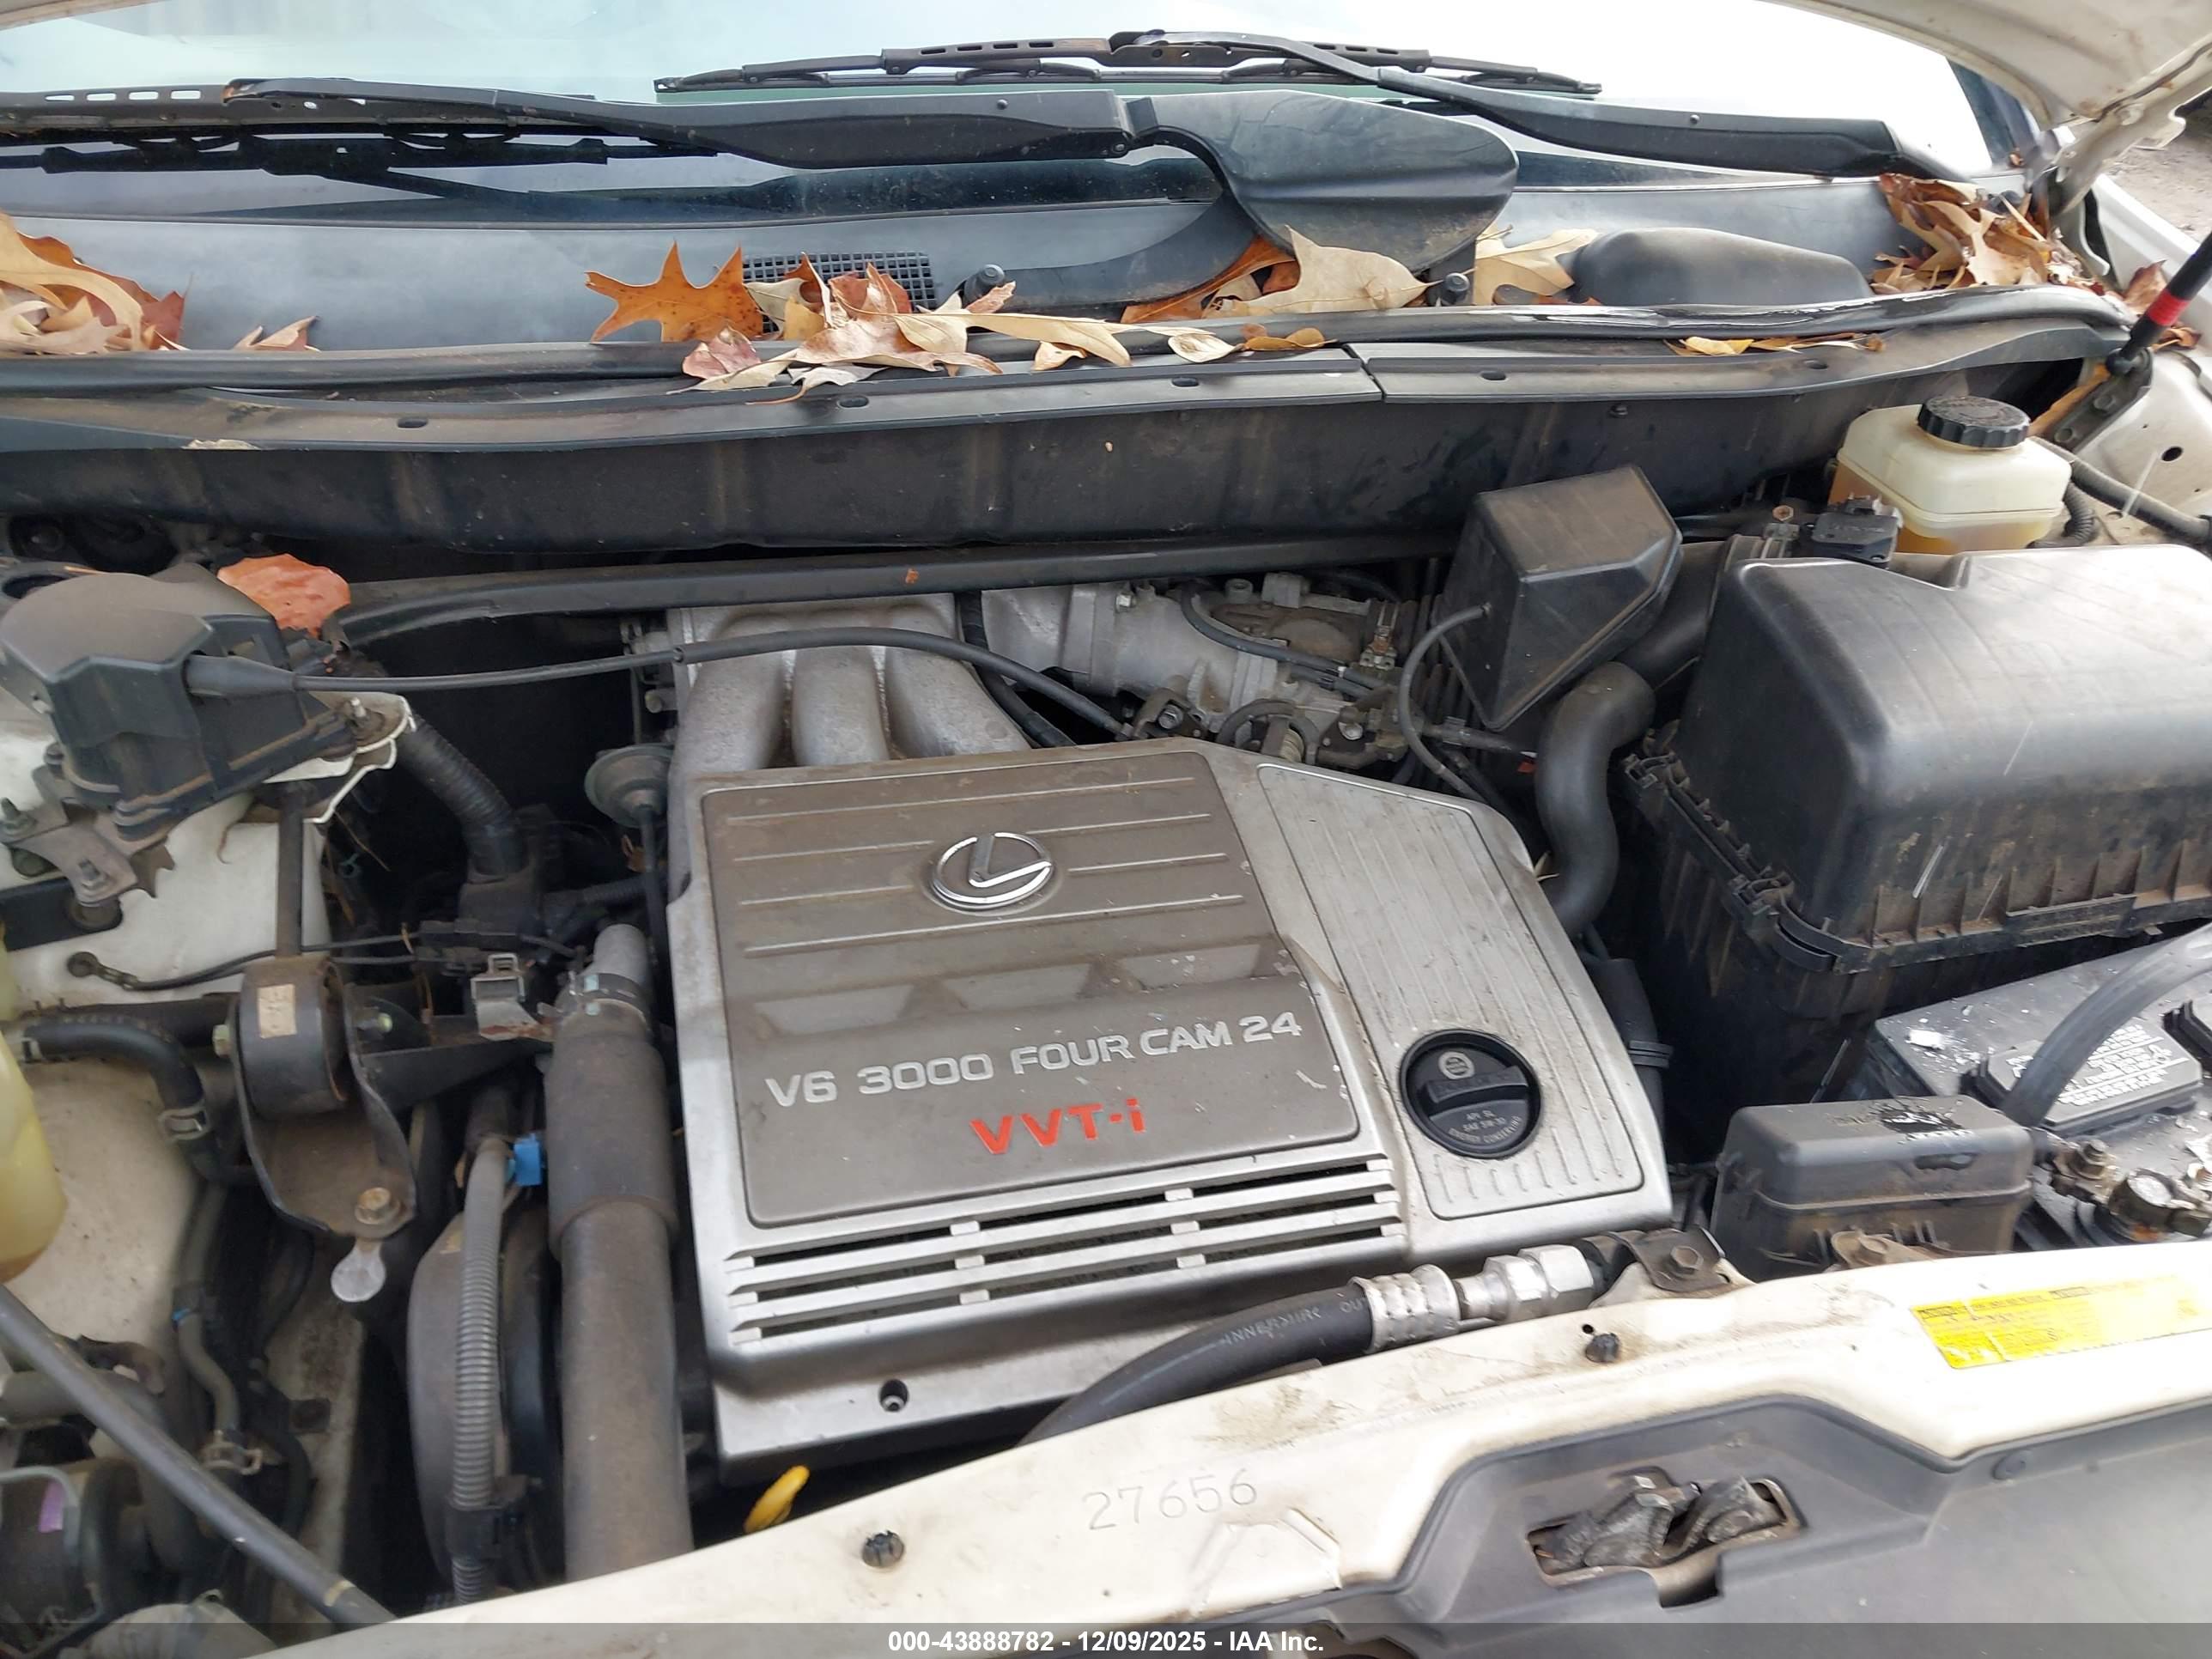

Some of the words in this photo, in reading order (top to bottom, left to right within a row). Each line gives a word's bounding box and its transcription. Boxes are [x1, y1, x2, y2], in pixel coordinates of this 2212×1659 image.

[765, 1069, 838, 1107] V6
[857, 1053, 994, 1095] 3000
[1010, 1034, 1134, 1074] FOUR
[1139, 1019, 1233, 1056] CAM
[1238, 1012, 1302, 1042] 24
[970, 1097, 1146, 1154] VVT-i
[1082, 1468, 1257, 1530] 27656
